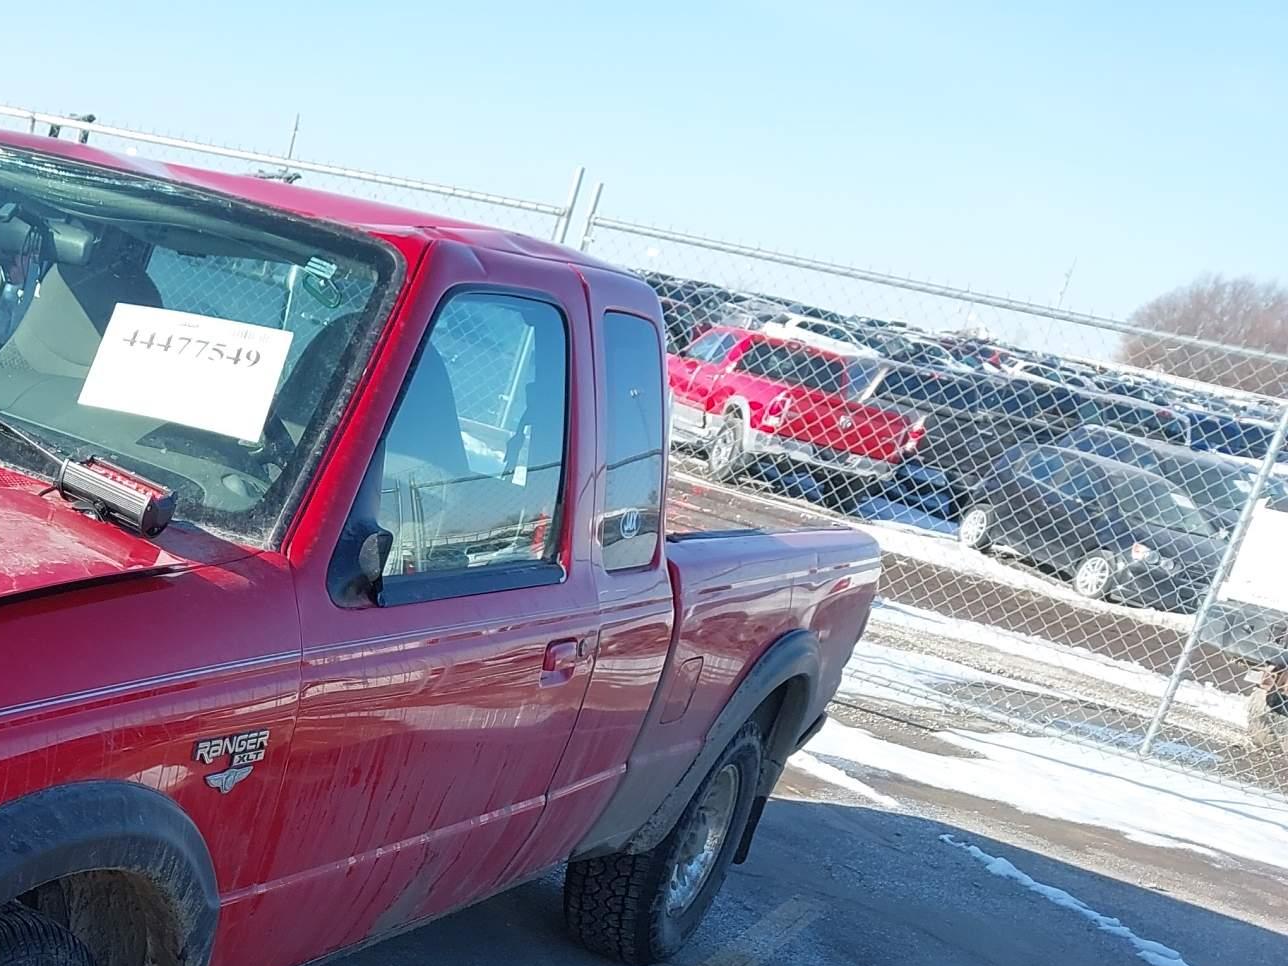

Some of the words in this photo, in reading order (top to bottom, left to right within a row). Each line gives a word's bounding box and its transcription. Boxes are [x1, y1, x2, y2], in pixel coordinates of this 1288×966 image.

[123, 329, 261, 367] 44477549
[196, 731, 270, 764] RANGER
[236, 751, 263, 764] XLT
